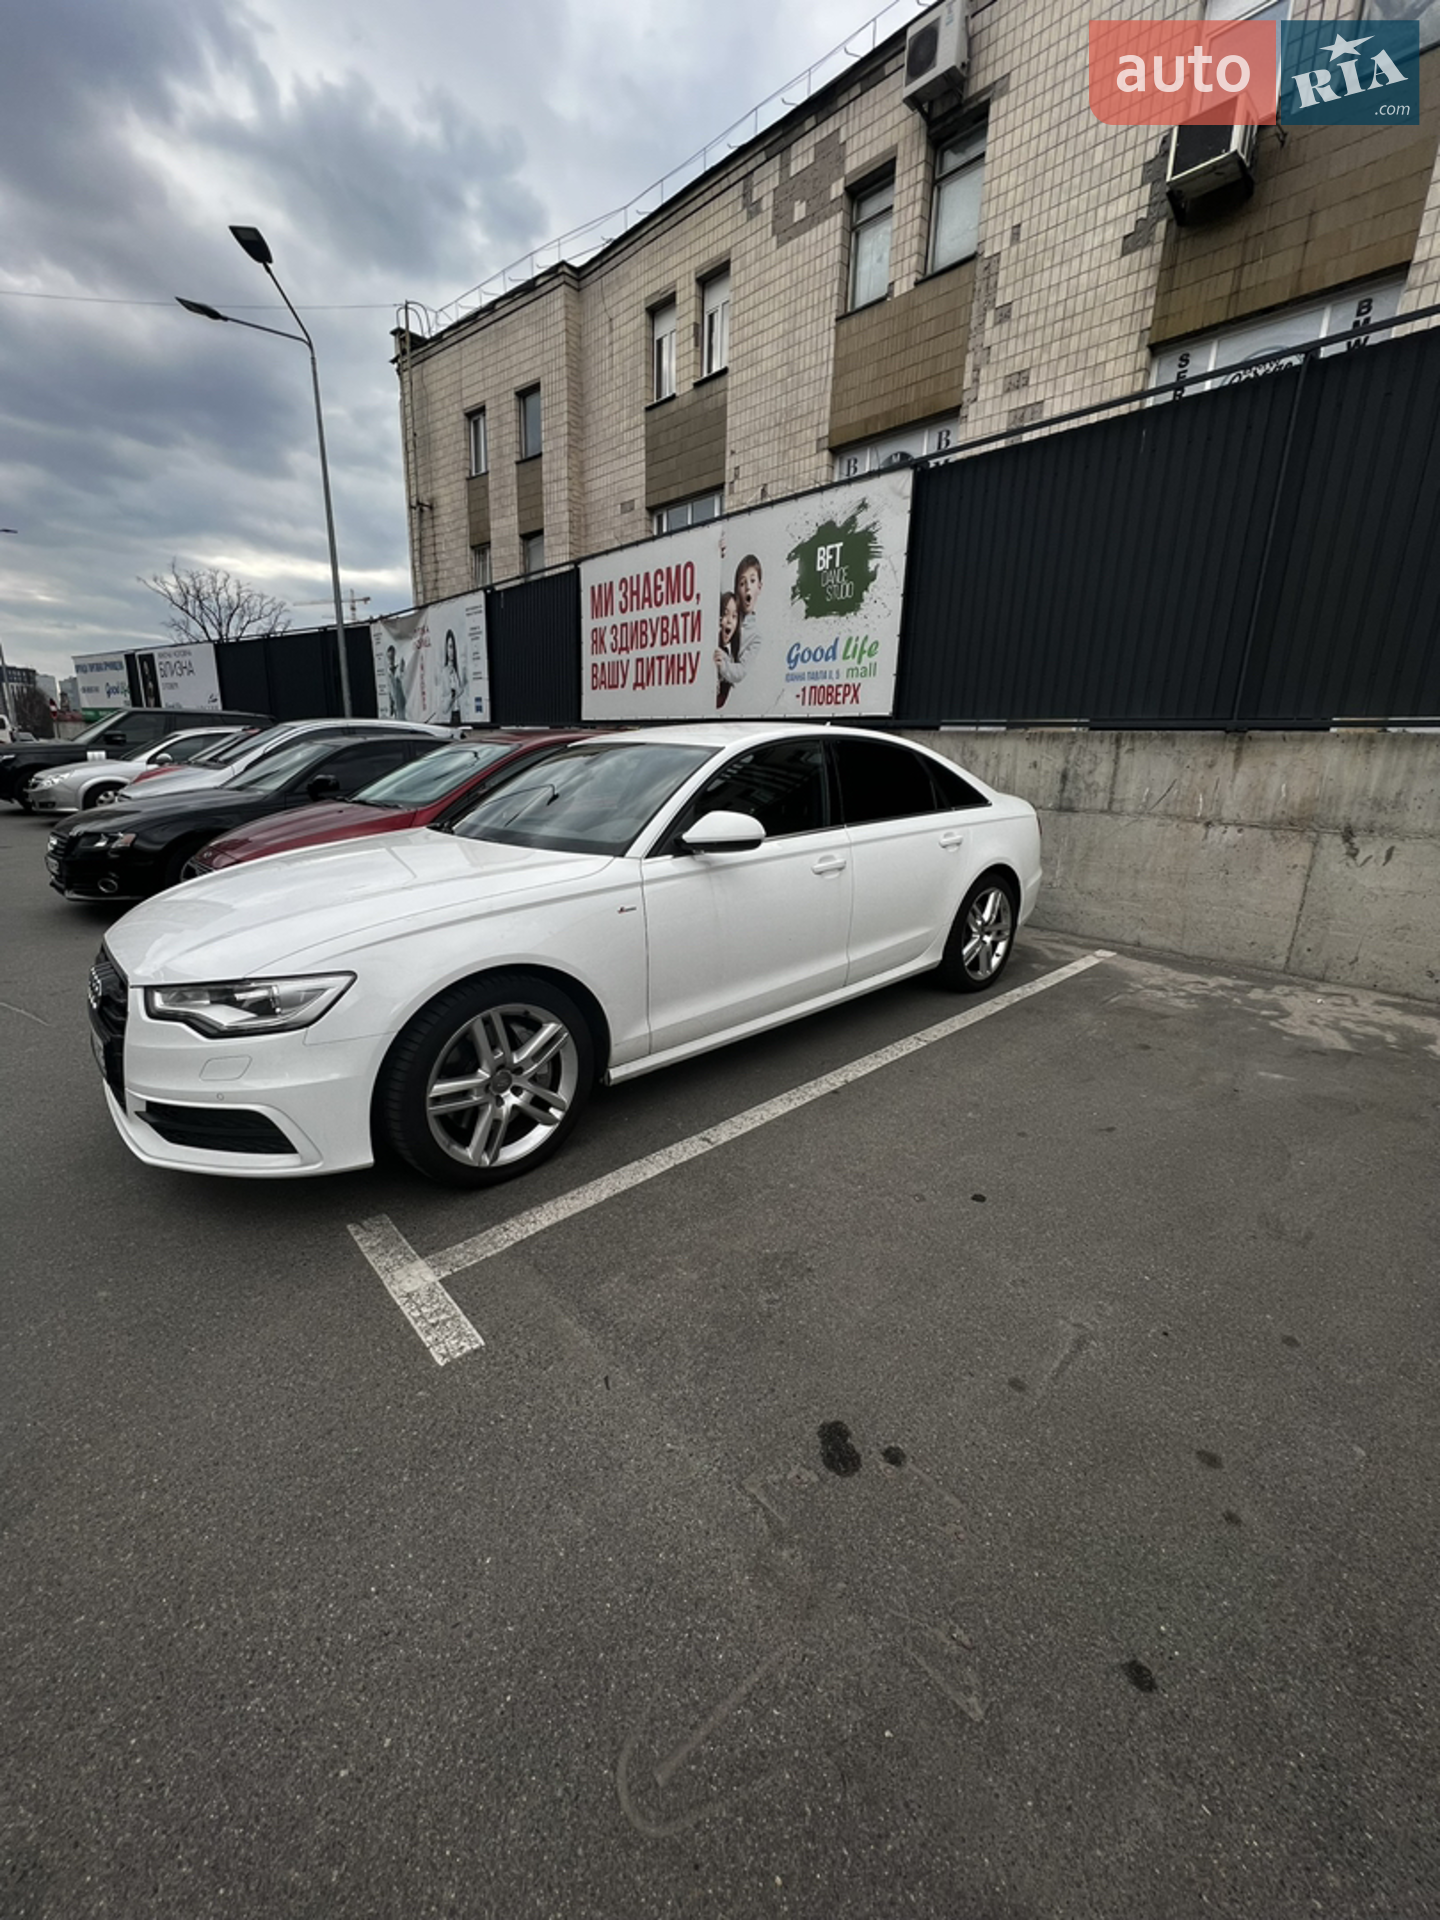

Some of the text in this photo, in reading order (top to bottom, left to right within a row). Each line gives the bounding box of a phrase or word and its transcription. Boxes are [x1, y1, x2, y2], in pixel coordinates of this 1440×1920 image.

[816, 541, 844, 571] BFT
[590, 561, 701, 620] МИ ЗНАЄМО,
[591, 609, 702, 656] ЯК ЗДИВУВАТИ
[591, 651, 701, 691] ВАШУ ДИТИНУ
[786, 635, 879, 671] Good Life
[845, 662, 877, 679] mall
[796, 682, 861, 706] -1 ПОВЕРХ
